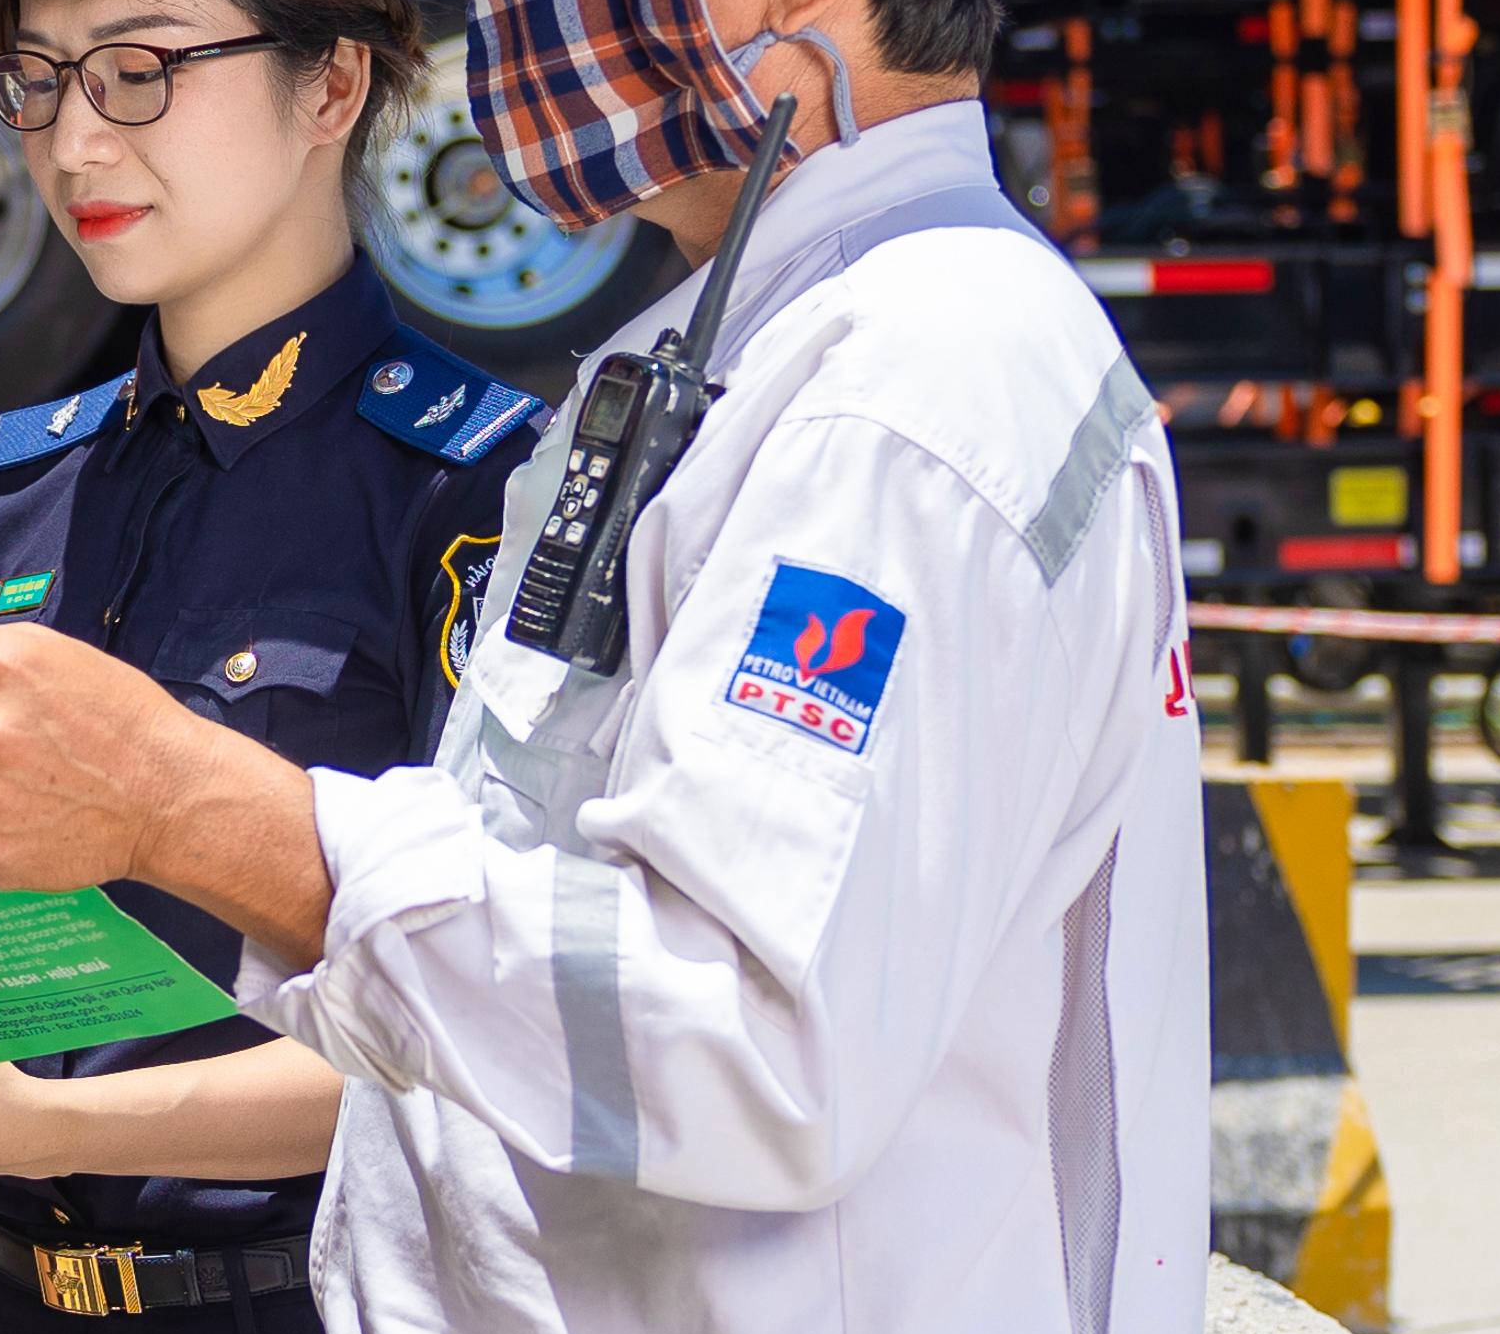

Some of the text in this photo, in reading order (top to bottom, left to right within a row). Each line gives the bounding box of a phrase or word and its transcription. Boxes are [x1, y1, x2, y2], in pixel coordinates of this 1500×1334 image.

[464, 563, 489, 588] HẢI
[737, 680, 857, 743] PTSC
[1, 973, 41, 987] BẠCH
[45, 965, 78, 980] HIỆU
[77, 956, 110, 973] QUẢ
